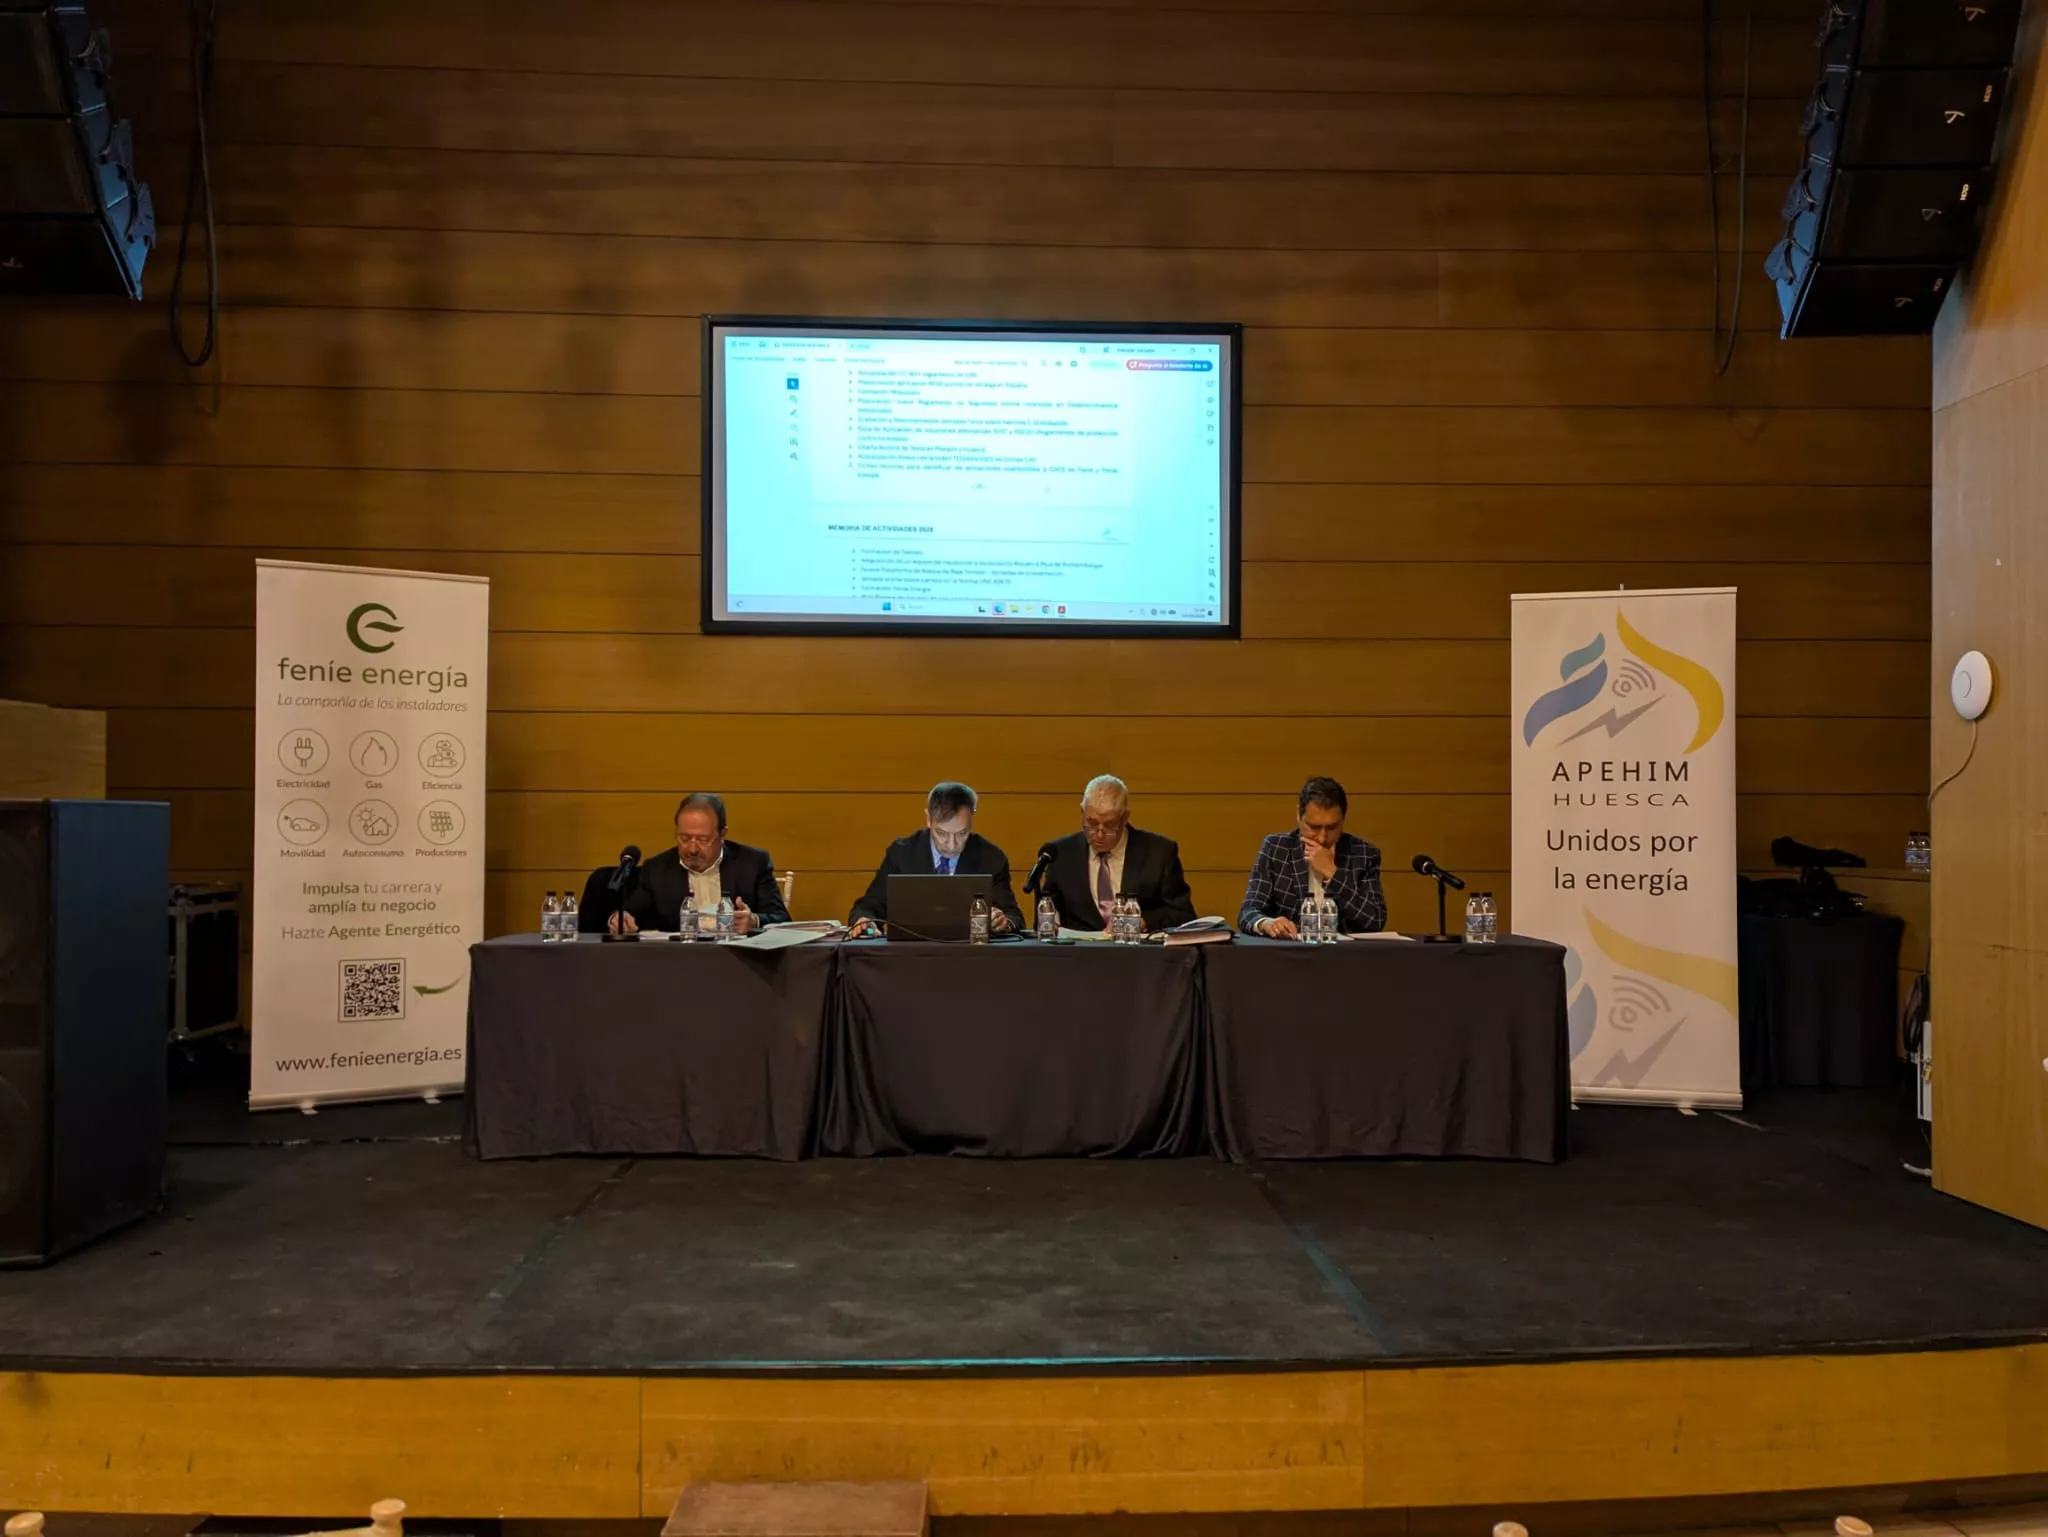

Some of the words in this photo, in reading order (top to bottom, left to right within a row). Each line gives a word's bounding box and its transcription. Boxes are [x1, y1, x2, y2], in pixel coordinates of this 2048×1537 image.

[828, 524, 860, 532] MEMORIA
[277, 657, 353, 683] feníe
[361, 666, 468, 694] energía
[277, 693, 292, 706] La
[359, 697, 375, 709] de
[376, 698, 394, 710] los
[396, 699, 468, 713] instaladores
[1551, 761, 1690, 782] APEHIM
[276, 779, 331, 789] Electricidad
[365, 780, 384, 790] Gas
[421, 781, 462, 791] Eficiencia
[1553, 793, 1690, 807] HUESCA
[1546, 828, 1641, 853] Unidos
[1651, 835, 1699, 857] por
[280, 849, 326, 858] Movilidad
[342, 849, 405, 858] Autoconsumo
[415, 848, 468, 858] Productores
[302, 881, 360, 897] Impulsa
[363, 883, 379, 895] tu
[381, 882, 432, 895] carrera
[432, 882, 444, 896] y
[1553, 866, 1576, 890] la
[1585, 867, 1689, 896] energía
[308, 900, 357, 916] amplía
[361, 901, 376, 913] tu
[380, 899, 437, 914] negocio
[281, 926, 326, 940] Hazte
[328, 925, 381, 941] Agente
[385, 923, 462, 940] Energético
[276, 1047, 463, 1073] www.fenieenergia.es
